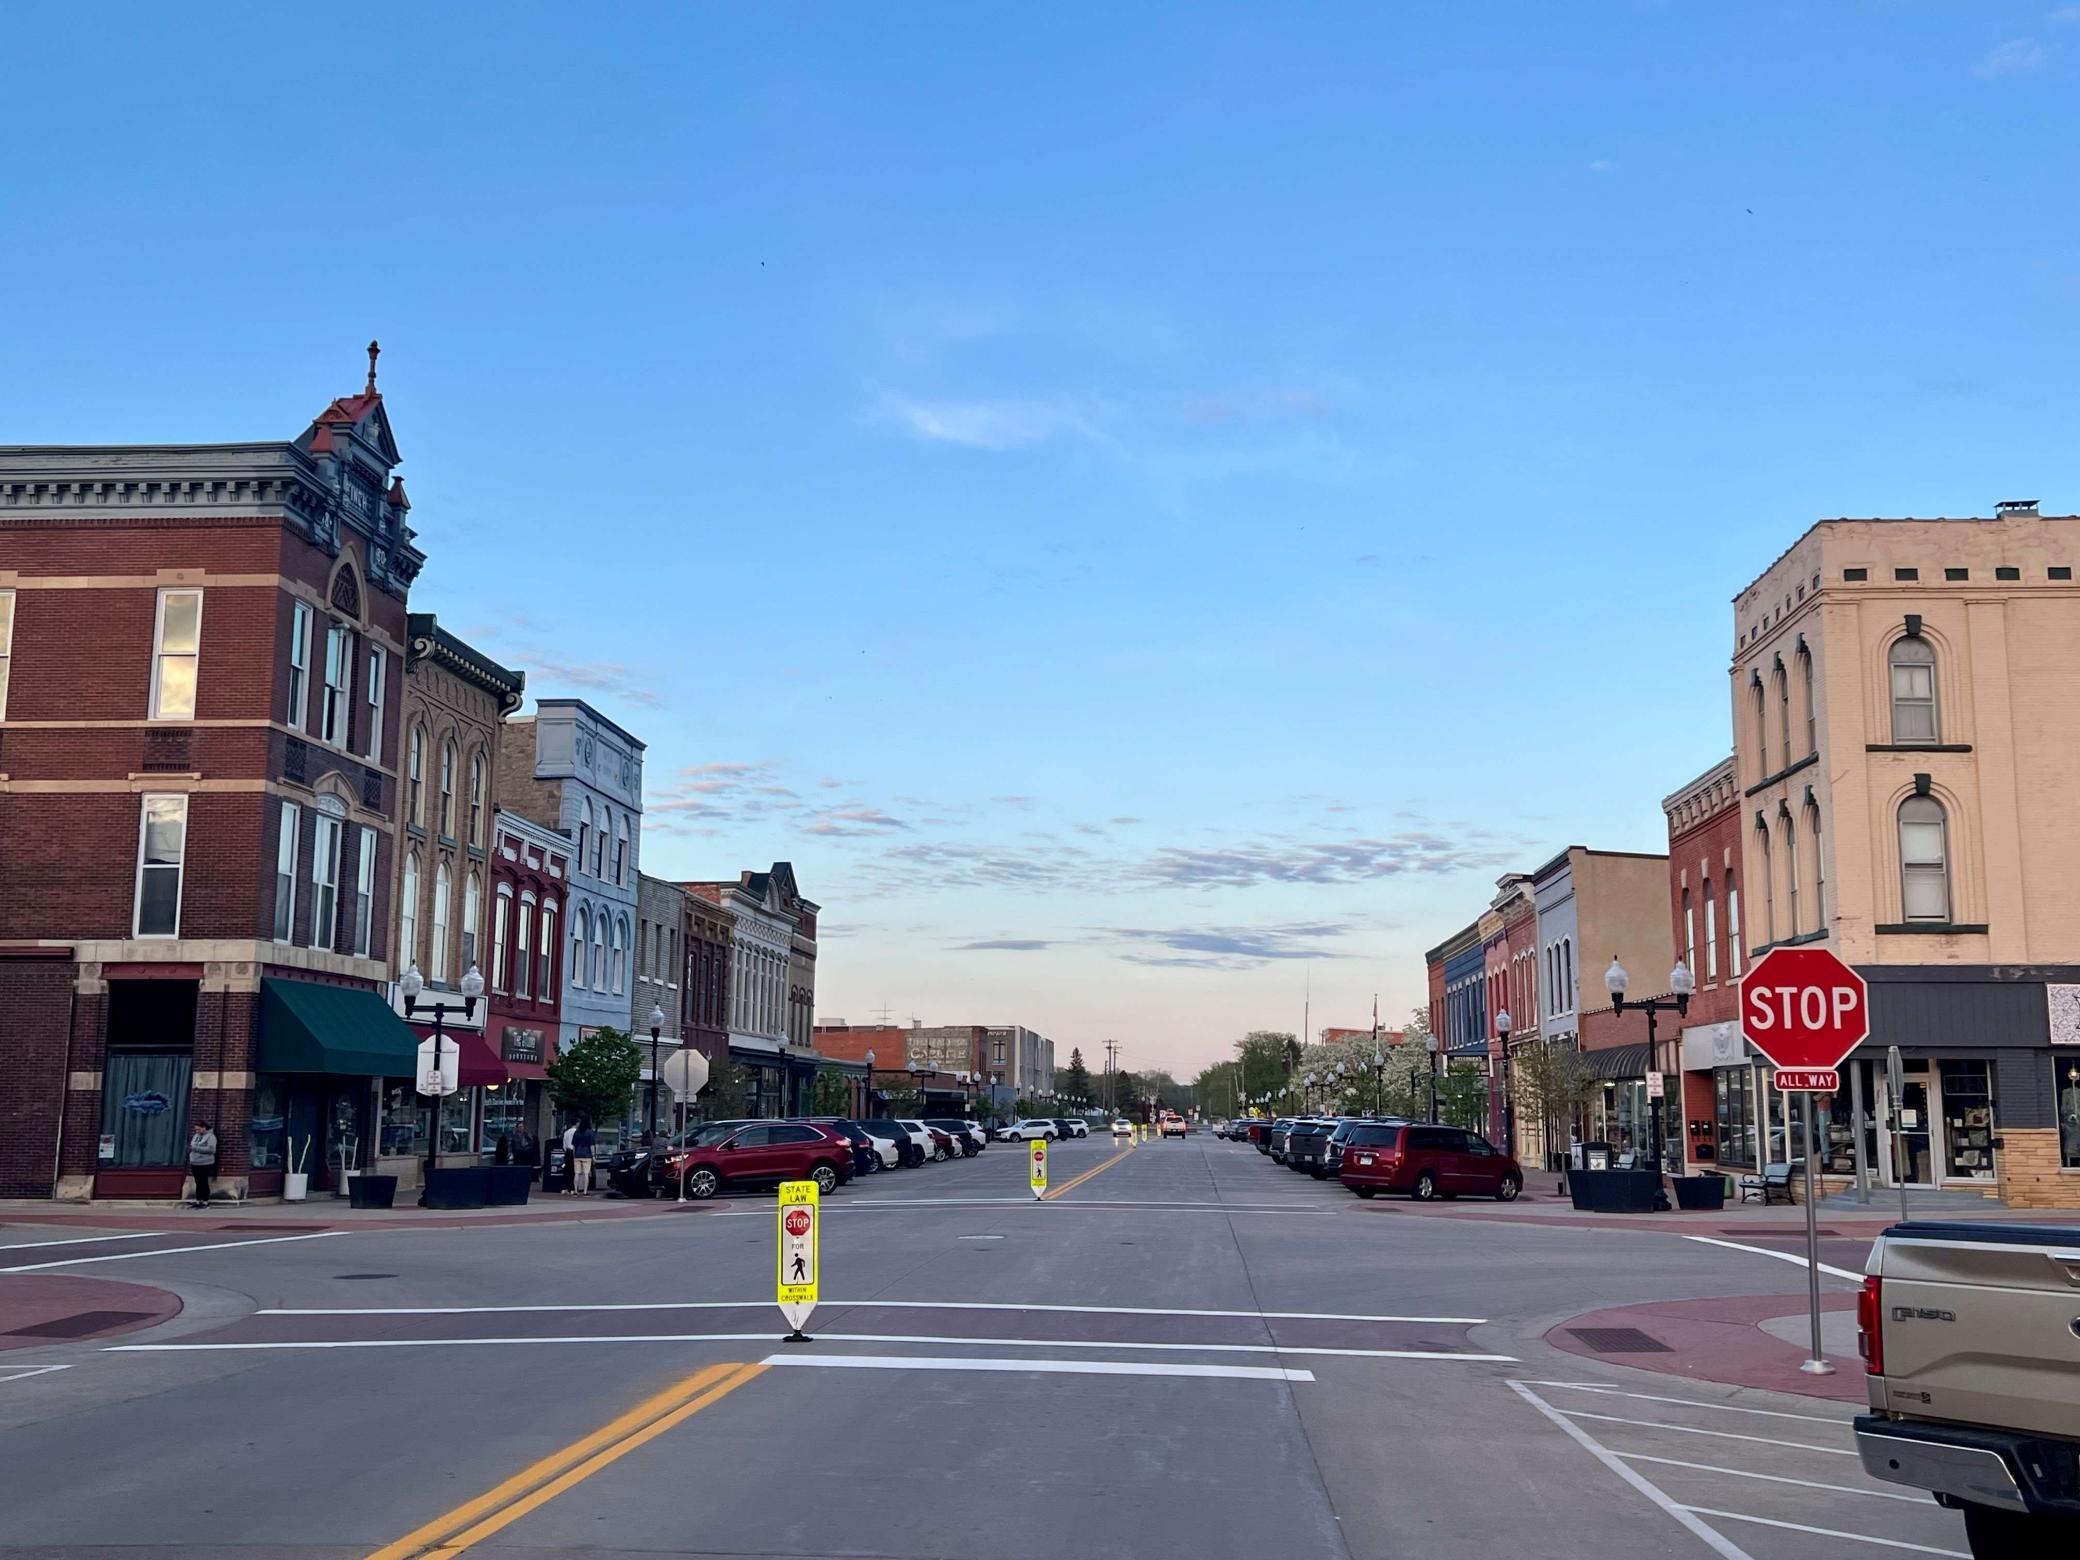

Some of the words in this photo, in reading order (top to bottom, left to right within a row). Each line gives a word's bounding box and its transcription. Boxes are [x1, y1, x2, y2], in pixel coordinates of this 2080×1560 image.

[1750, 986, 1857, 1030] STOP
[1780, 1075, 1803, 1086] ALL
[1809, 1075, 1833, 1087] WAY
[786, 1185, 810, 1193] STATE
[790, 1194, 807, 1203] LAW
[787, 1218, 809, 1228] STOP
